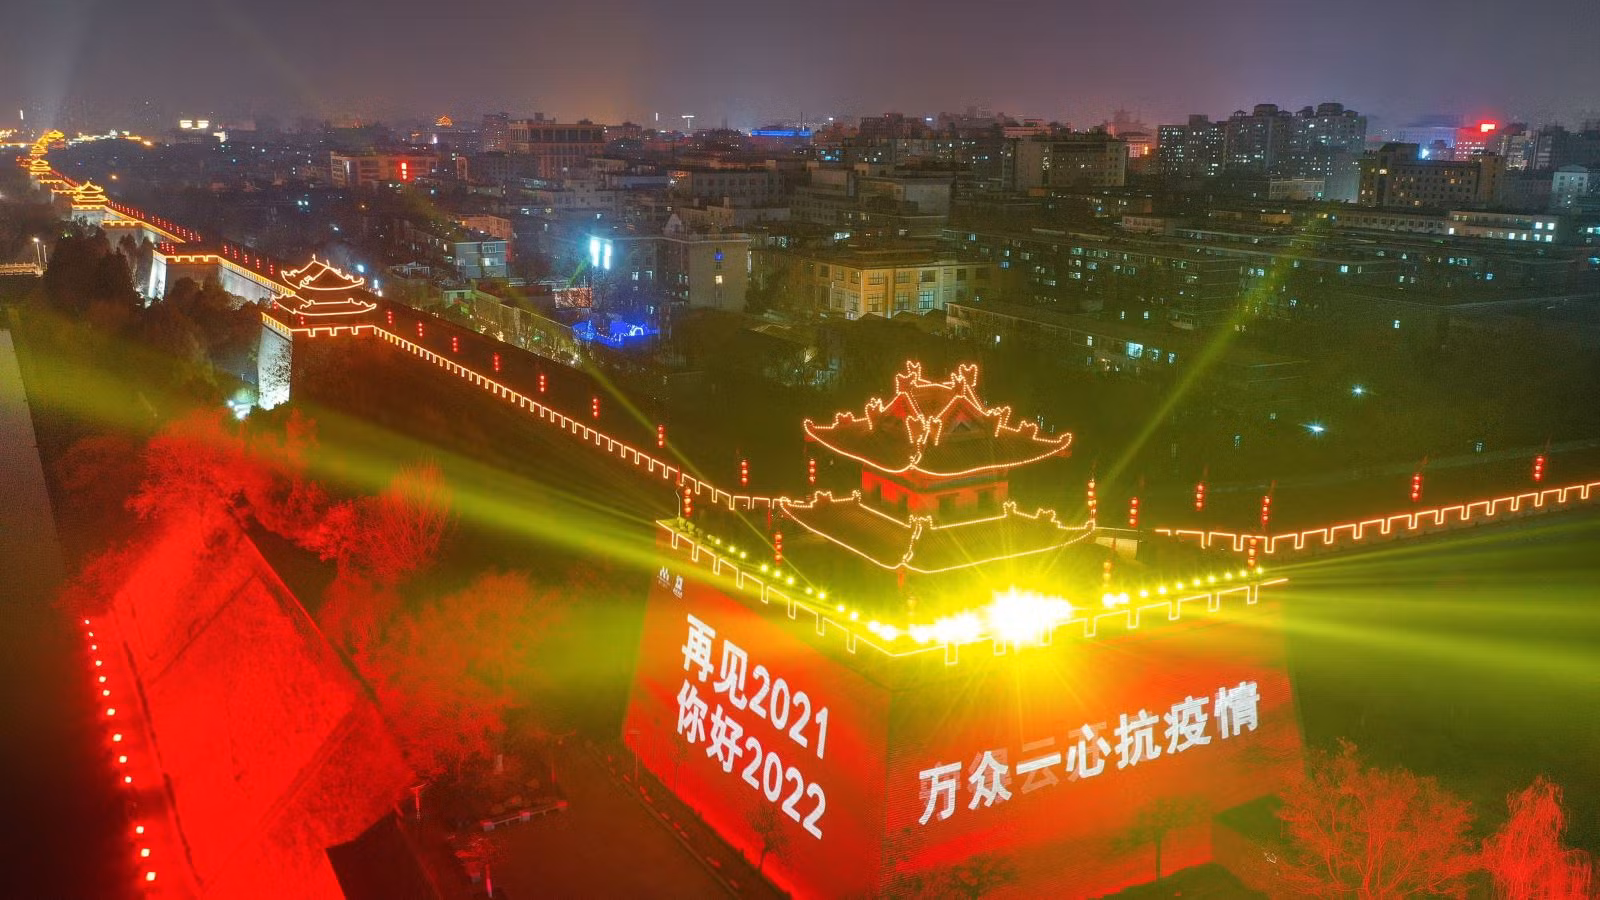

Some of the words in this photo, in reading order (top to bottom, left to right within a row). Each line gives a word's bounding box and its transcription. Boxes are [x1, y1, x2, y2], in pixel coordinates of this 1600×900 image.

[682, 613, 829, 759] 再见2021
[918, 680, 1261, 826] 万众一心抗疫情
[676, 679, 826, 840] 你好2022
